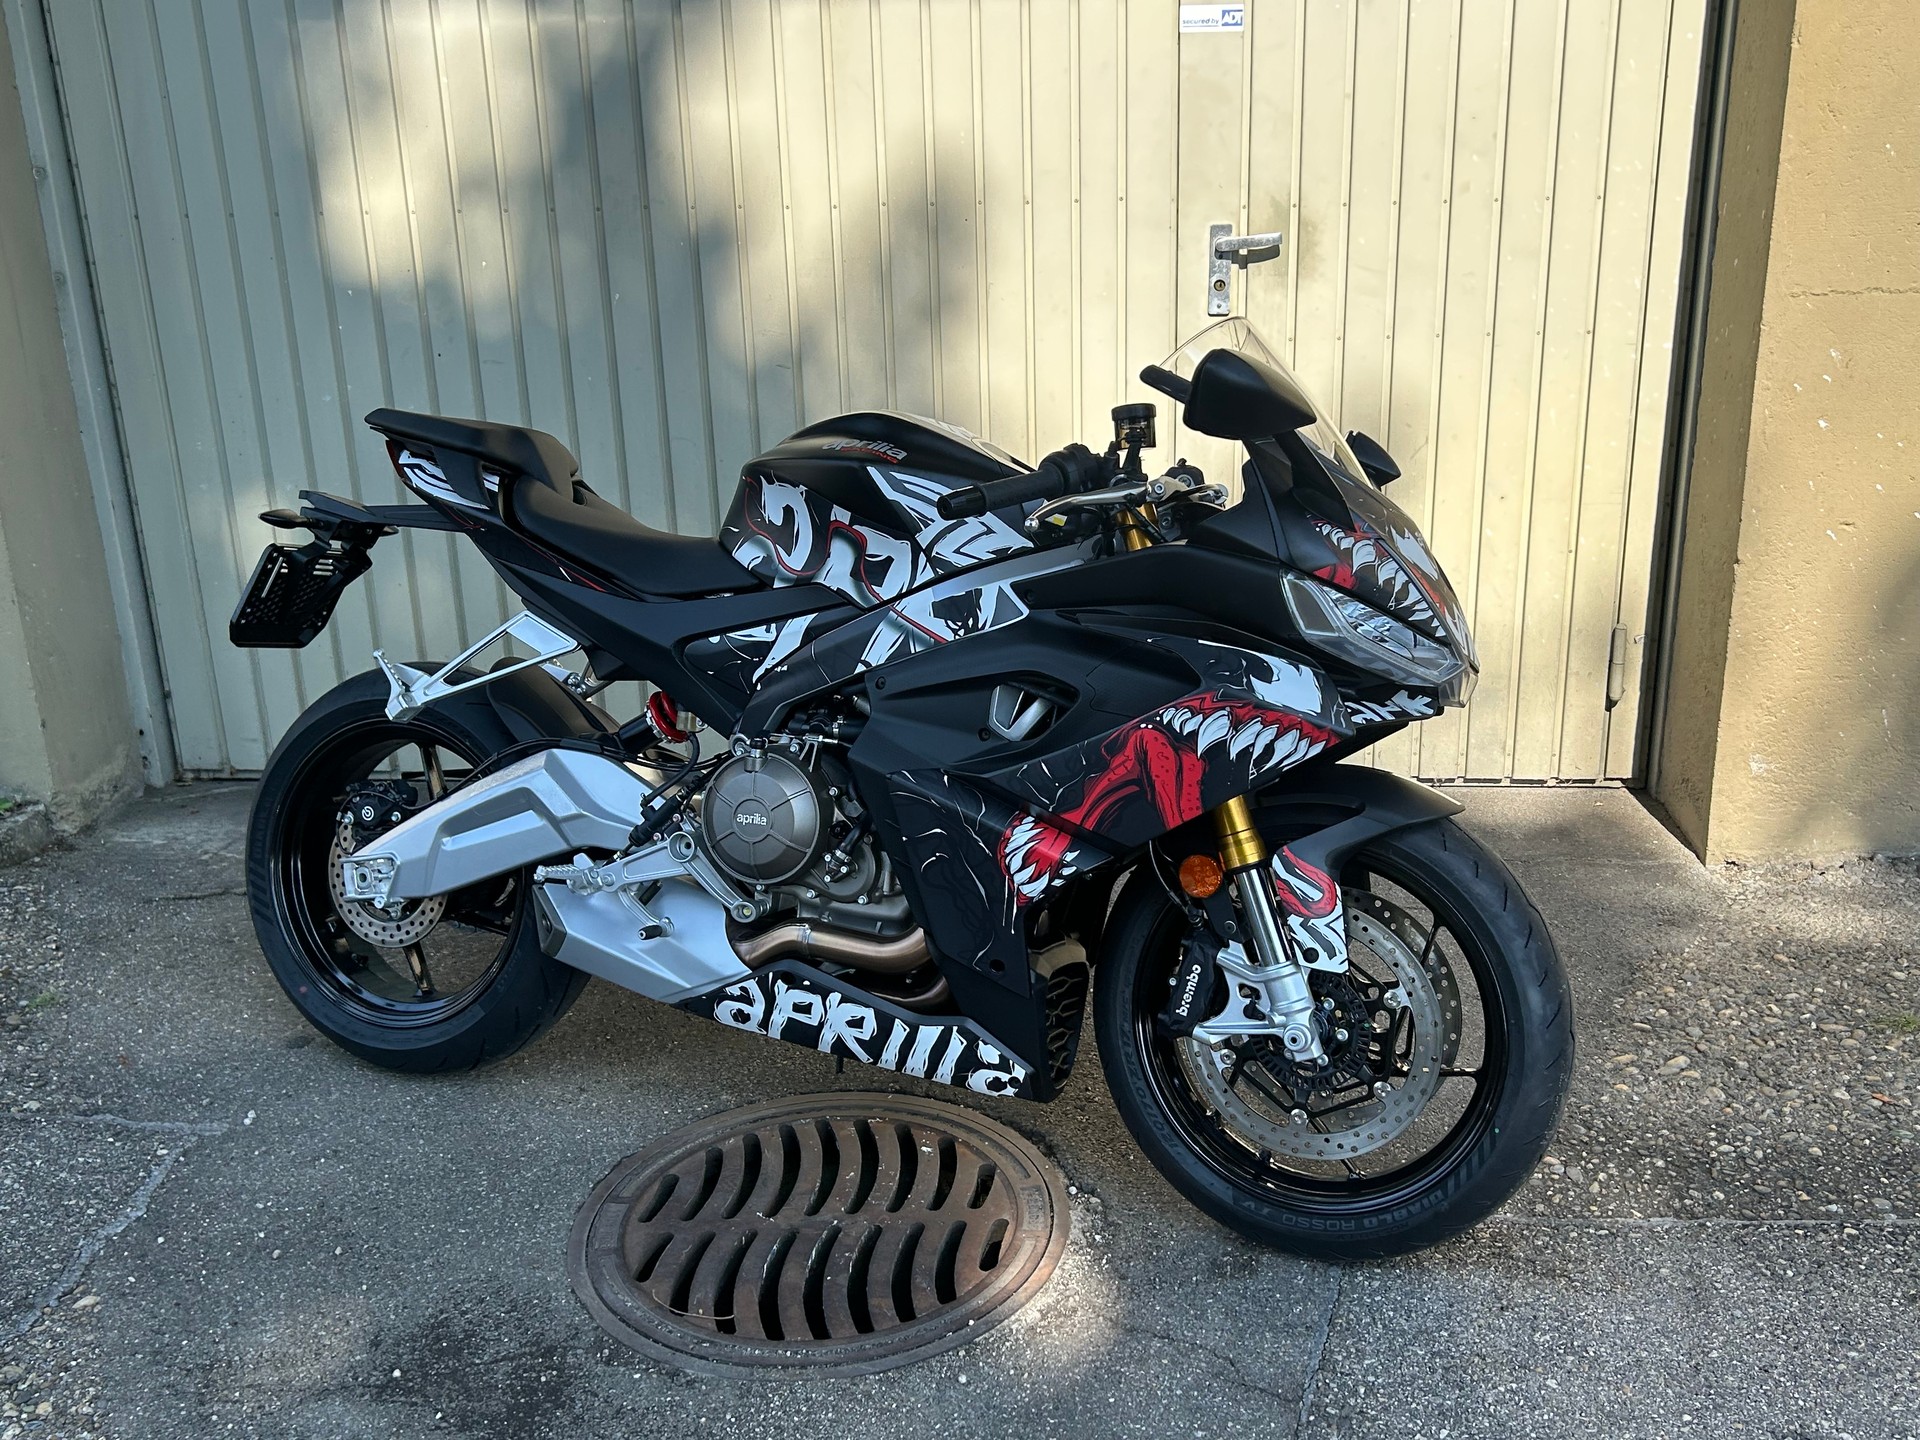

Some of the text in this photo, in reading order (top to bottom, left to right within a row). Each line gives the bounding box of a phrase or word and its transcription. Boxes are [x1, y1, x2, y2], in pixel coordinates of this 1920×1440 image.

[1221, 9, 1243, 26] ADT
[822, 439, 907, 460] aprilia
[736, 813, 767, 826] aprilia
[1175, 964, 1201, 1017] brembo
[1363, 1188, 1445, 1229] DIABLO
[1282, 1213, 1355, 1231] ROSSO
